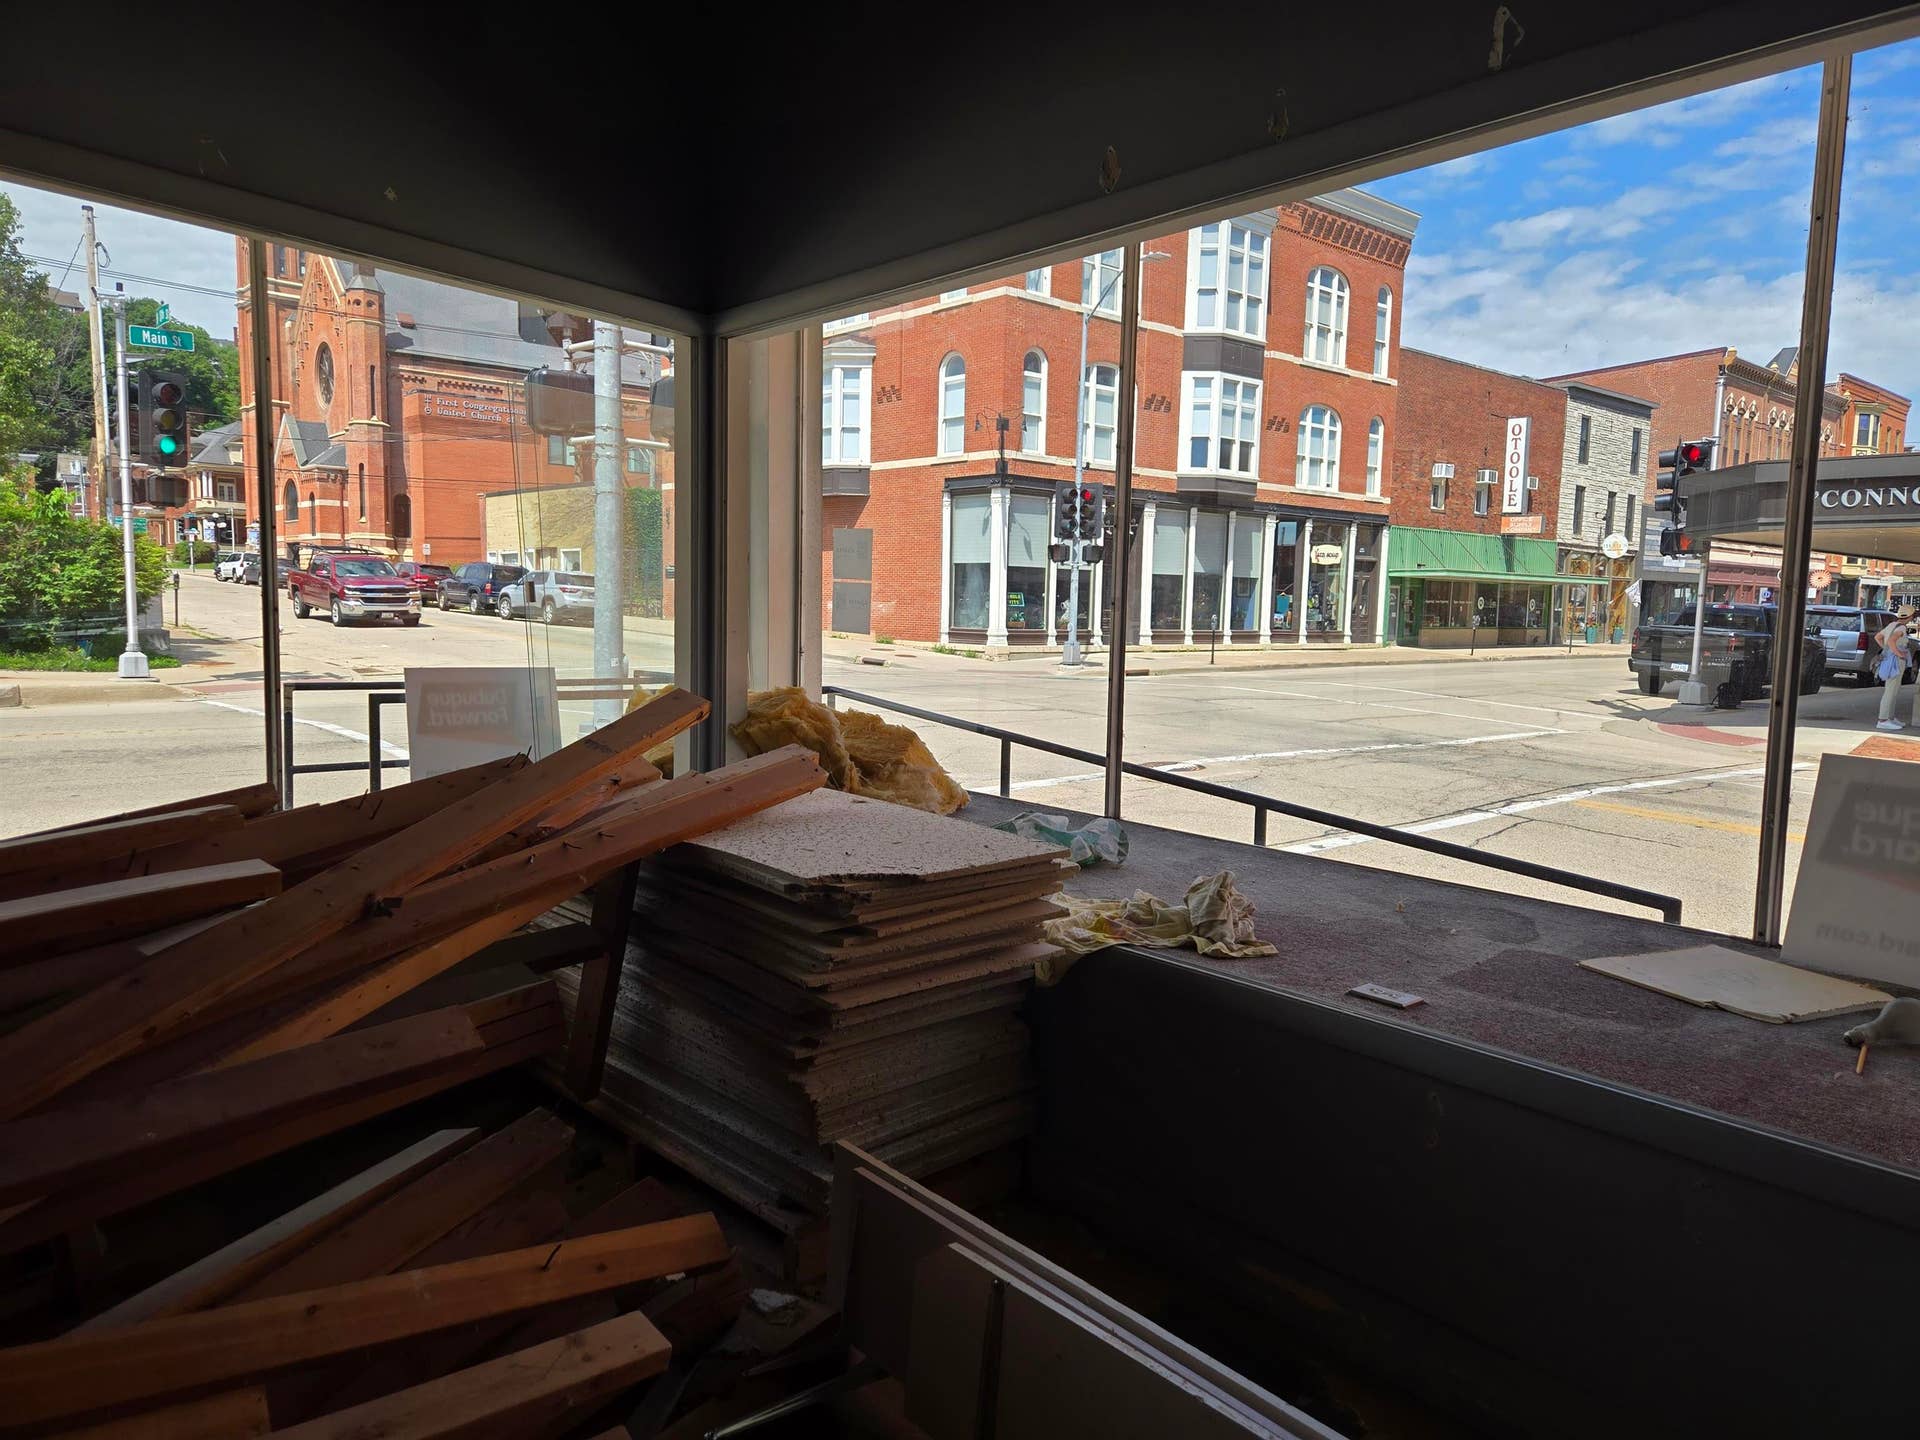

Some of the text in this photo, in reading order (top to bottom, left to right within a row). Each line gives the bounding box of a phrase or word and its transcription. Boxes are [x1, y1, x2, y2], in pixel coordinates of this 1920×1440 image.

[142, 330, 182, 347] Main St
[436, 397, 458, 408] First
[437, 407, 466, 418] United
[471, 411, 502, 422] Church
[1508, 423, 1522, 507] OTOOLE
